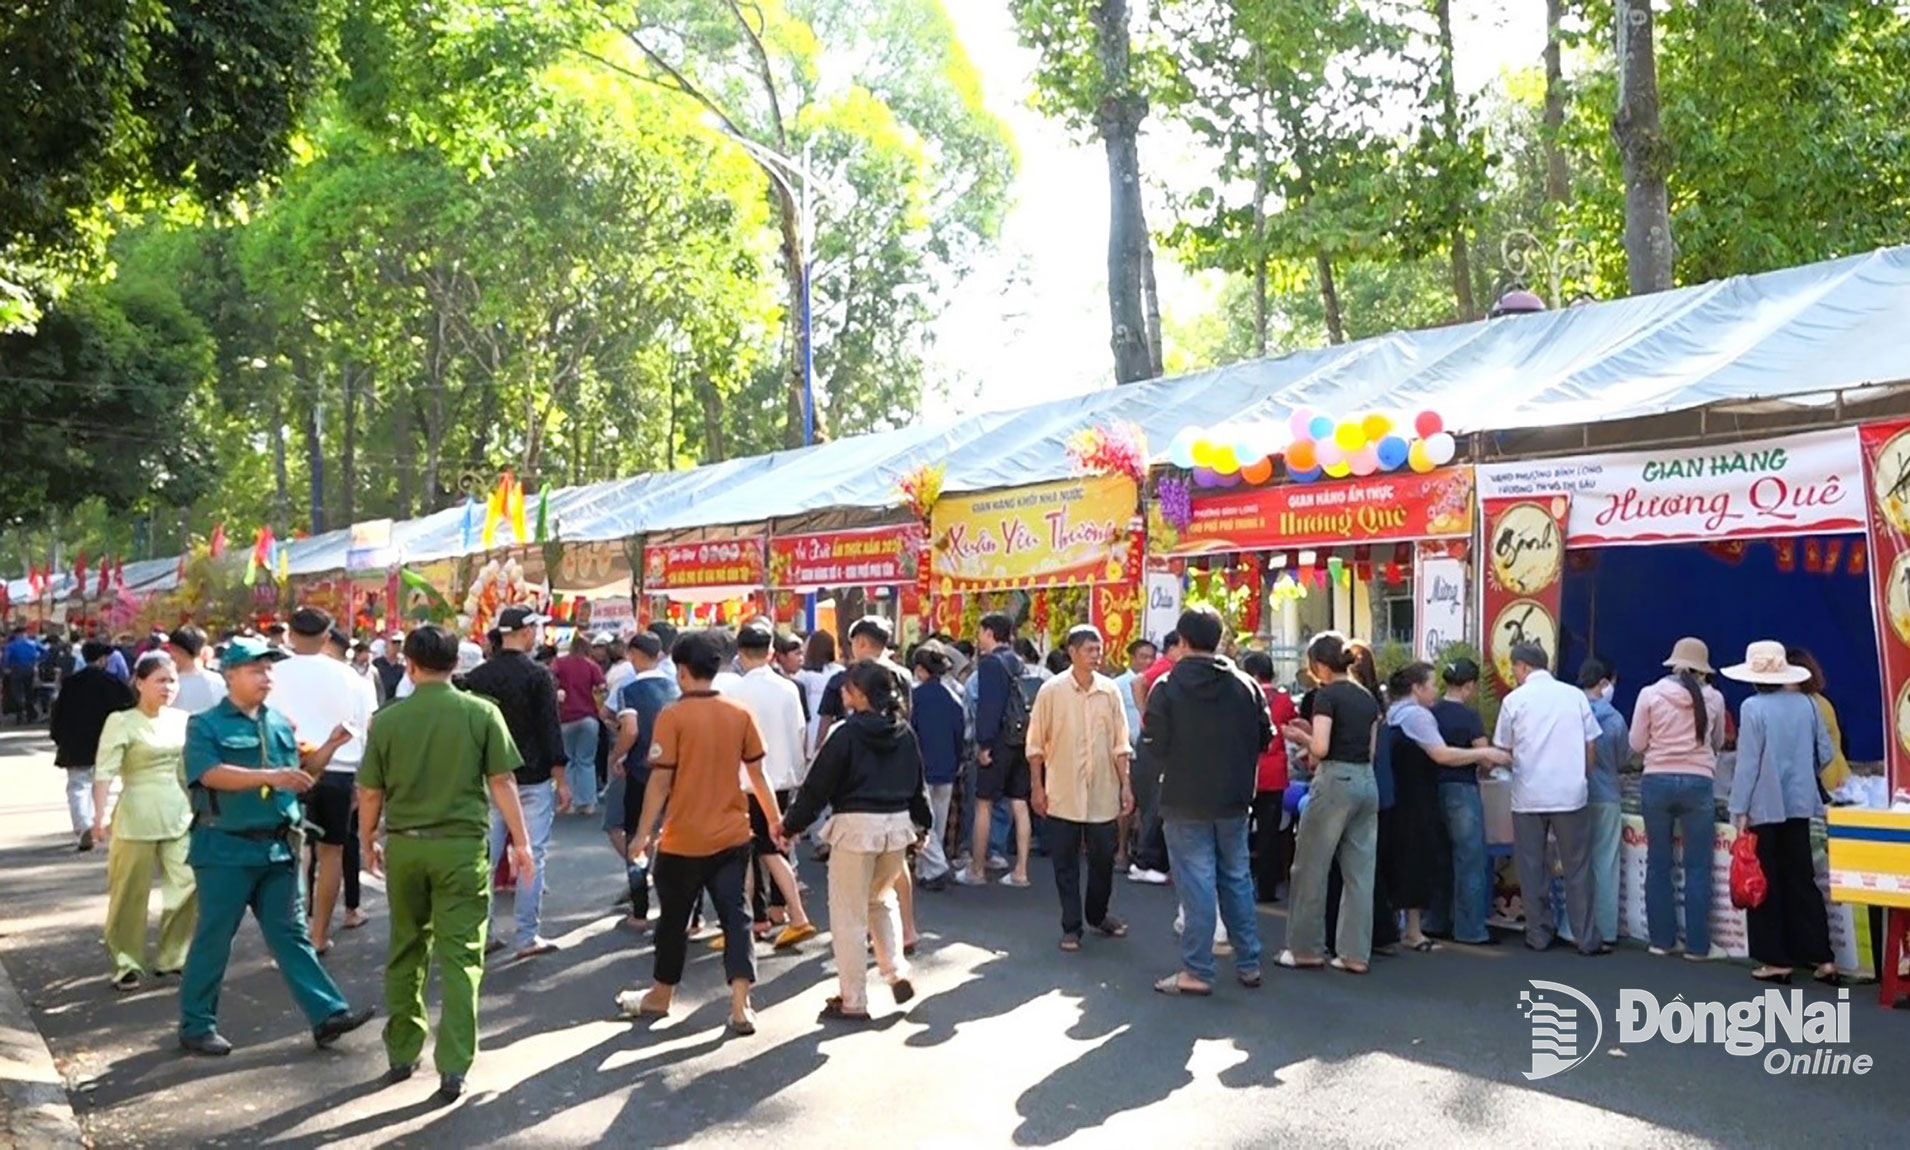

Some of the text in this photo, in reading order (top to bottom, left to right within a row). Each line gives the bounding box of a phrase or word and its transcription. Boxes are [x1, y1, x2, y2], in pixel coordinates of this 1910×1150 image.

[1642, 457, 1704, 482] GIAN
[1288, 495, 1315, 508] GIAN
[1595, 487, 1744, 531] Hương
[1749, 475, 1847, 519] Quê
[949, 524, 997, 558] Xuân
[1001, 518, 1039, 555] Yêu
